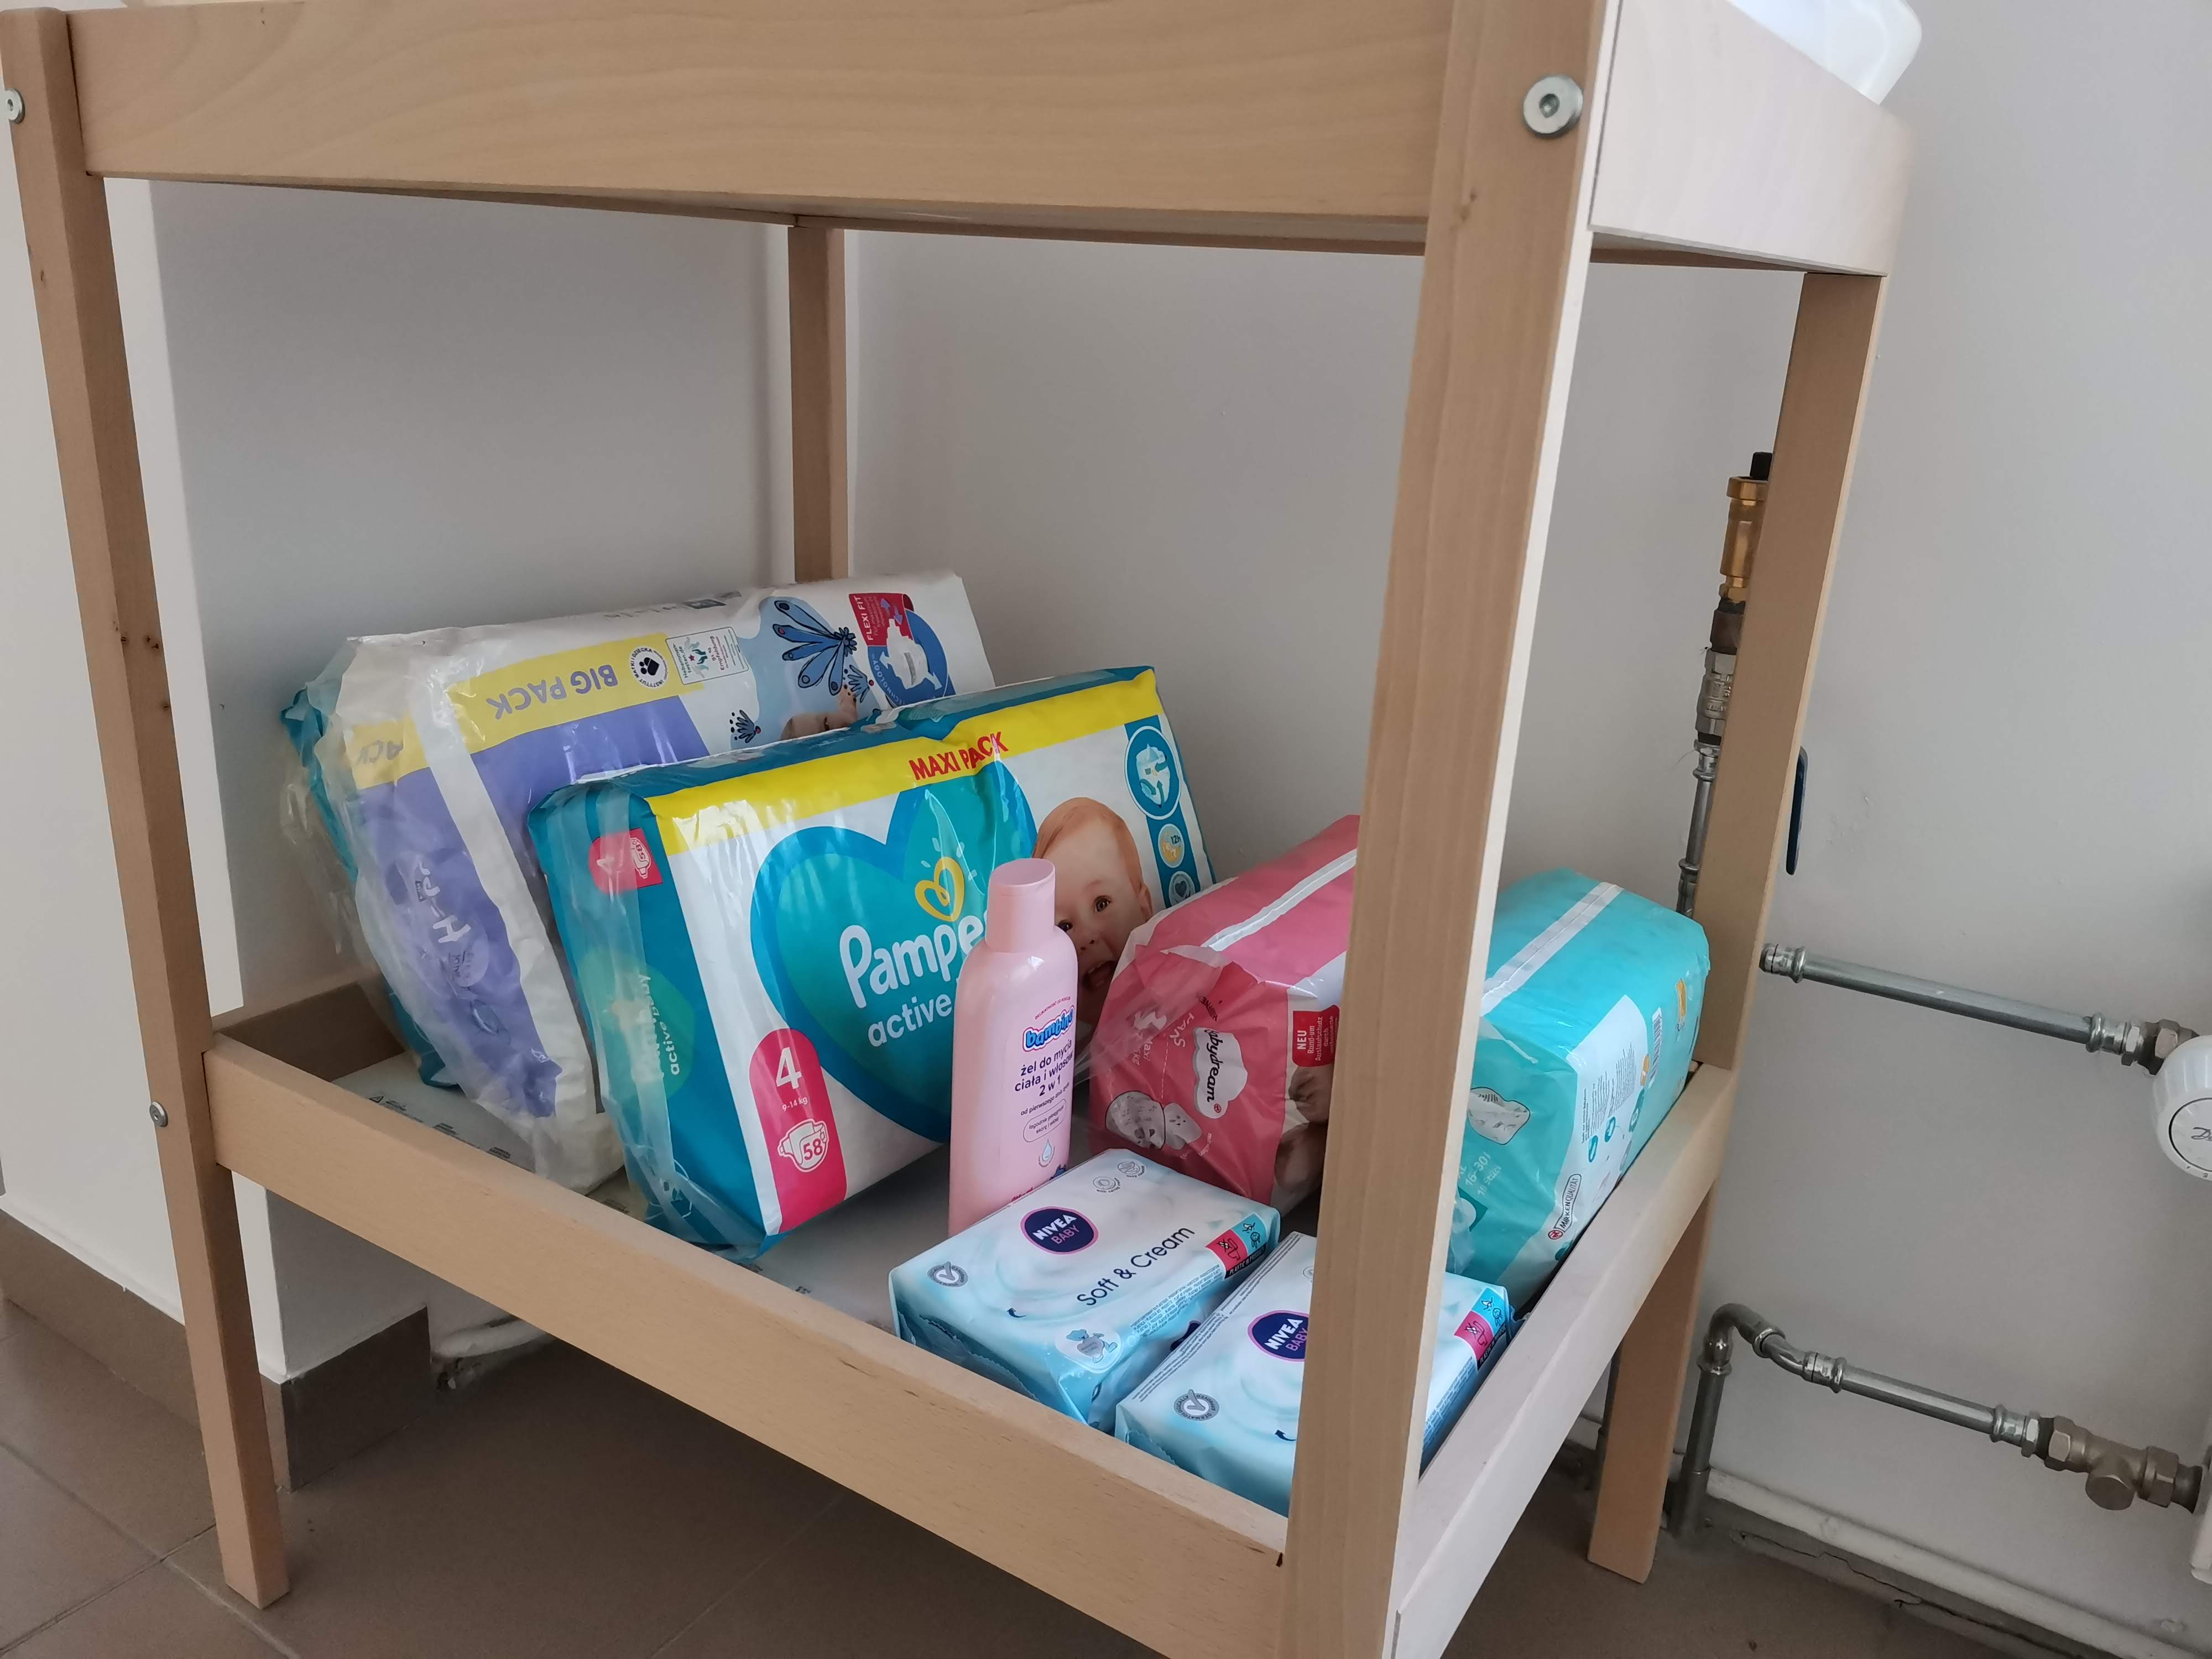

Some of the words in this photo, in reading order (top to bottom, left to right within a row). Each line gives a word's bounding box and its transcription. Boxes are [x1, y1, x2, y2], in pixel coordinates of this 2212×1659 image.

[854, 596, 866, 611] FIT
[861, 613, 874, 640] FLEXI
[570, 664, 618, 695] BIG
[486, 676, 567, 720] PACK
[908, 751, 961, 781] MAXI
[958, 731, 1009, 769] PACK
[1170, 834, 1182, 844] 12h
[839, 915, 988, 1009] Pampe
[868, 994, 952, 1047] active
[1025, 1008, 1073, 1048] bambino
[1297, 1030, 1307, 1050] NEU
[1315, 1016, 1323, 1061] Auslaufschutz
[776, 1047, 802, 1089] 4
[1015, 1076, 1041, 1092] ciała
[1044, 1070, 1046, 1081] i
[1049, 1048, 1073, 1078] włosów
[1020, 1060, 1036, 1076] żel
[1039, 1056, 1052, 1069] do
[1053, 1039, 1072, 1062] mycia
[1039, 1084, 1045, 1097] 2
[1048, 1081, 1056, 1091] w
[1057, 1074, 1061, 1085] 1
[781, 1099, 798, 1112] 9-14
[799, 1097, 808, 1106] kg
[803, 1138, 823, 1160] 58
[1032, 1214, 1077, 1240] NIVEA
[1051, 1224, 1079, 1244] BABY
[1077, 1278, 1119, 1306] Soft
[1113, 1269, 1136, 1279] &
[1130, 1228, 1195, 1267] Cream
[1264, 1318, 1303, 1350] NIVEA
[1285, 1328, 1308, 1351] BABY
